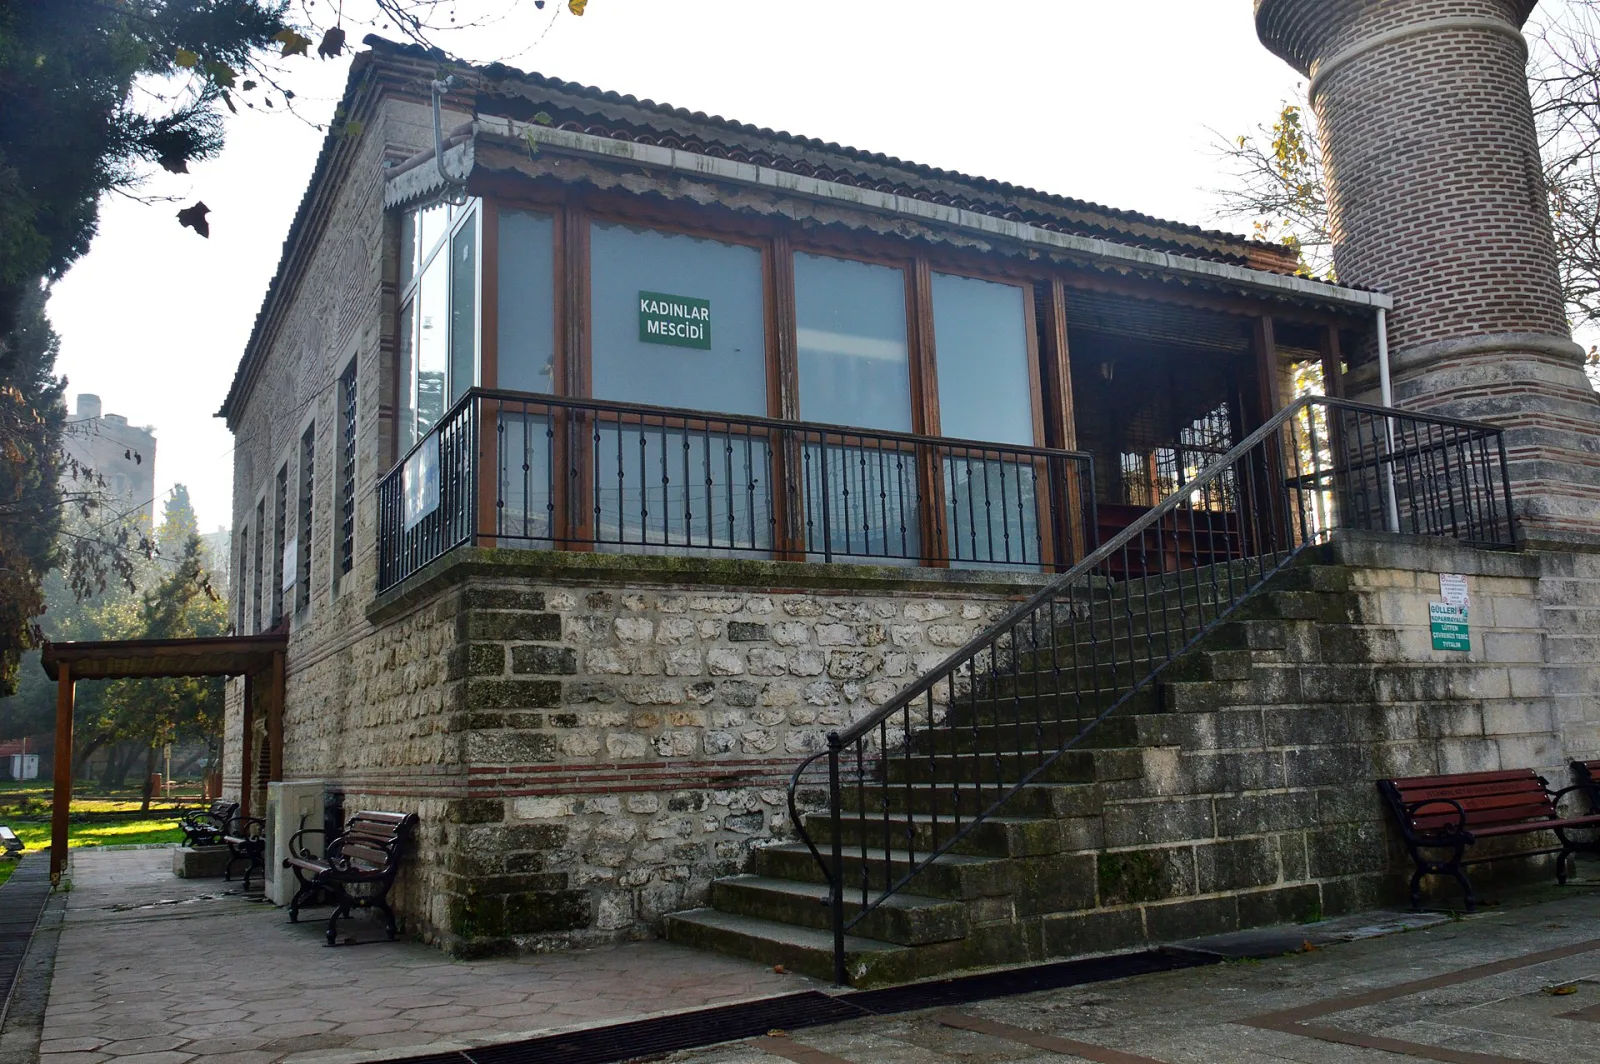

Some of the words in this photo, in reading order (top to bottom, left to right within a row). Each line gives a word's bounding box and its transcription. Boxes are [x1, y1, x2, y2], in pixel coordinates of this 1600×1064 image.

[641, 299, 709, 321] KADINLAR
[647, 320, 703, 340] MESCİDİ
[1431, 605, 1457, 614] GÜLLERİ
